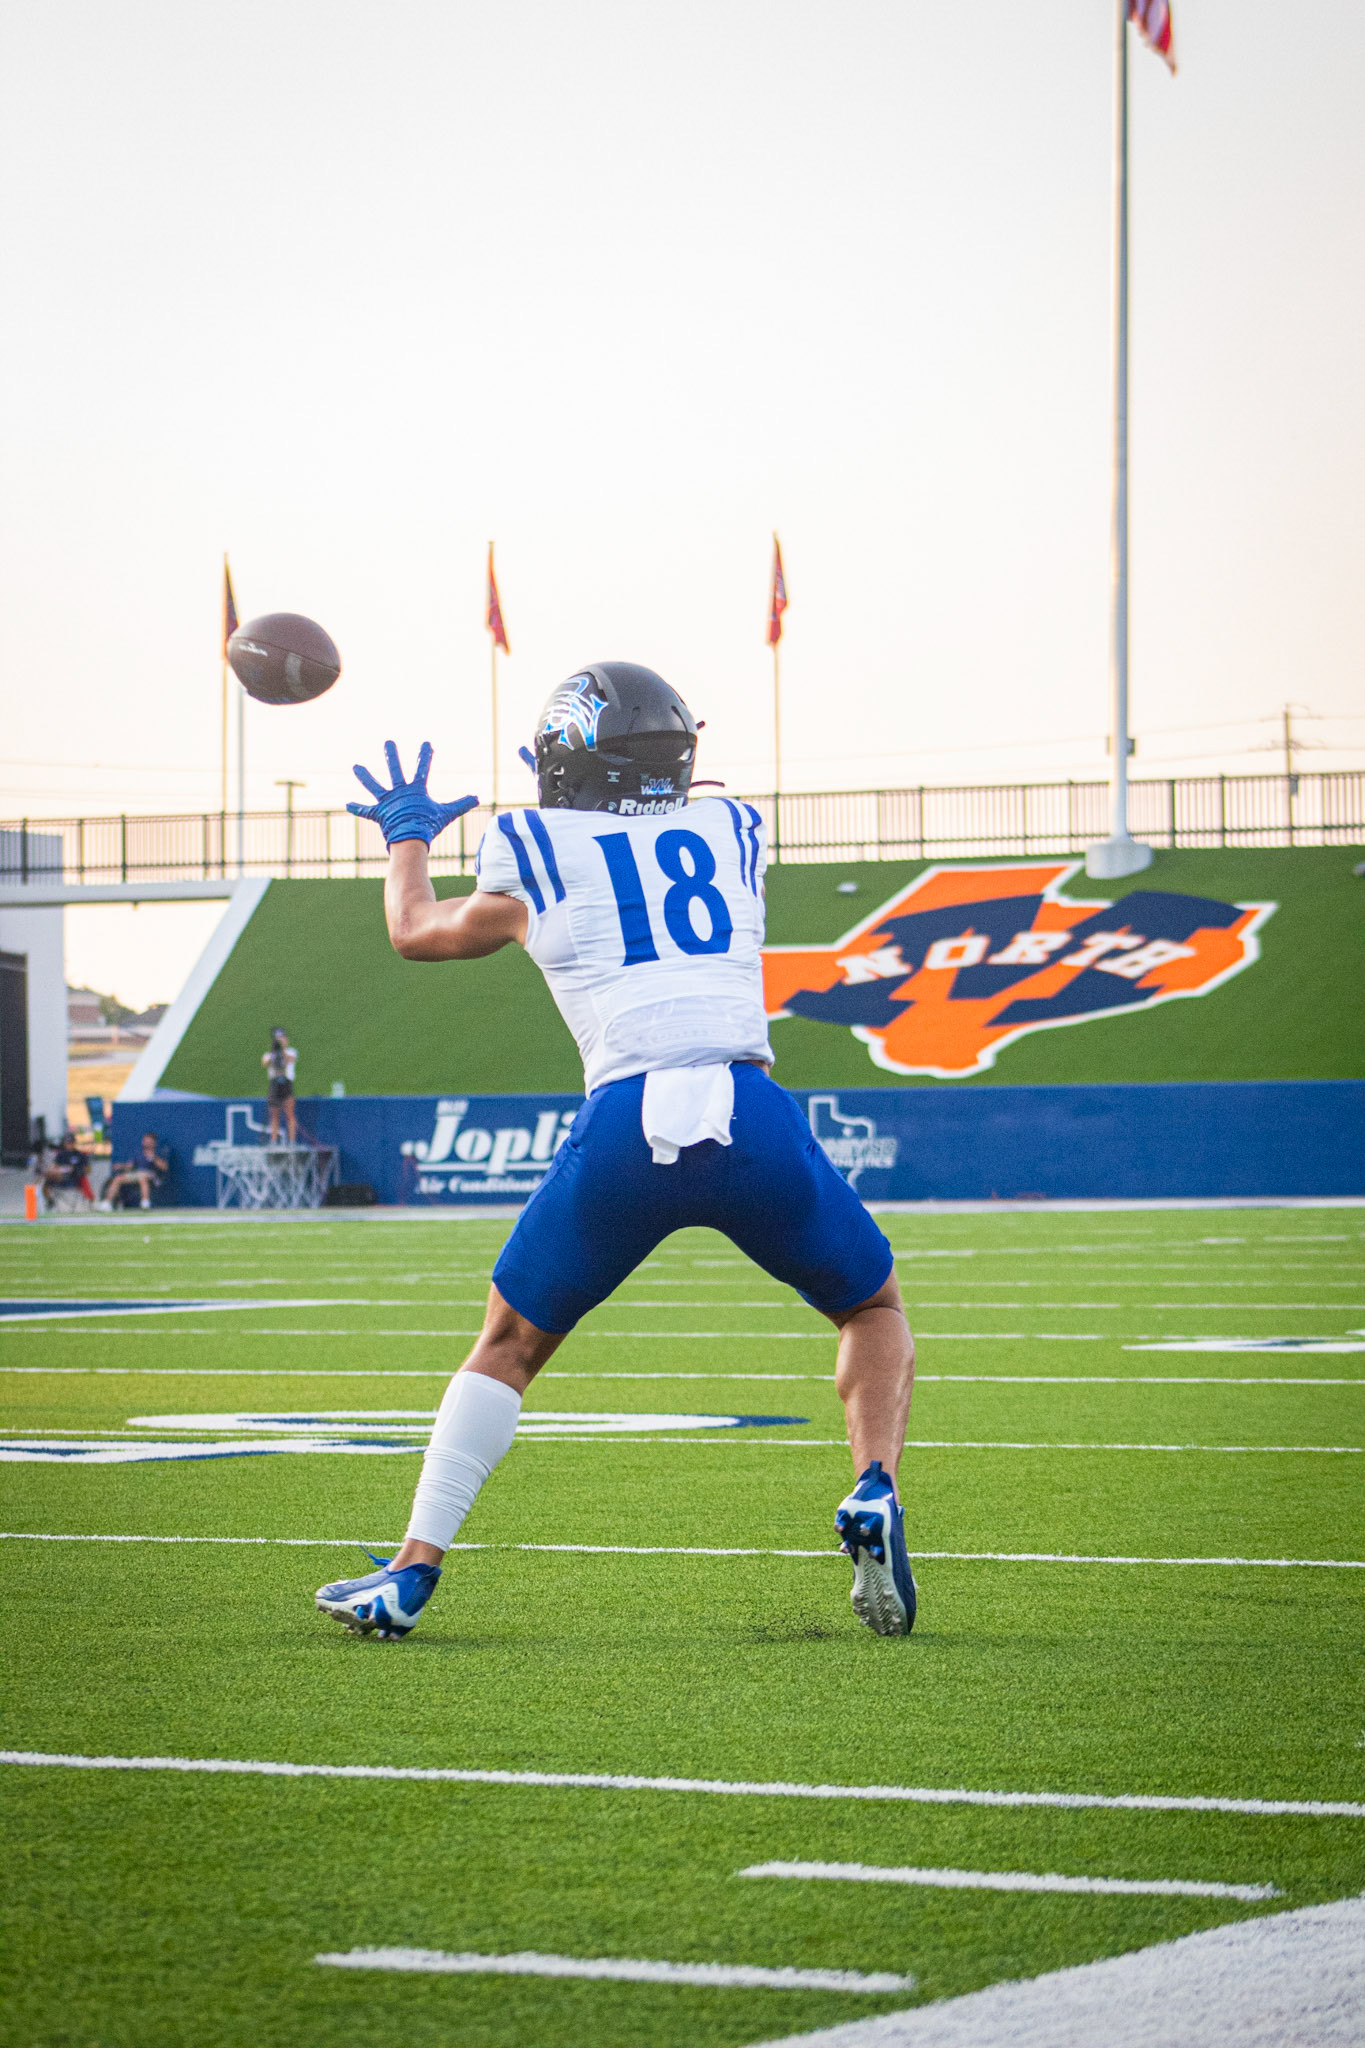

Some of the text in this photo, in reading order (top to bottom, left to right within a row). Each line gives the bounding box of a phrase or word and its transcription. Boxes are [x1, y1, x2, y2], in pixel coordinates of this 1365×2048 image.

[619, 797, 684, 816] Riddell
[592, 829, 733, 966] 18
[835, 931, 1197, 985] NORTH
